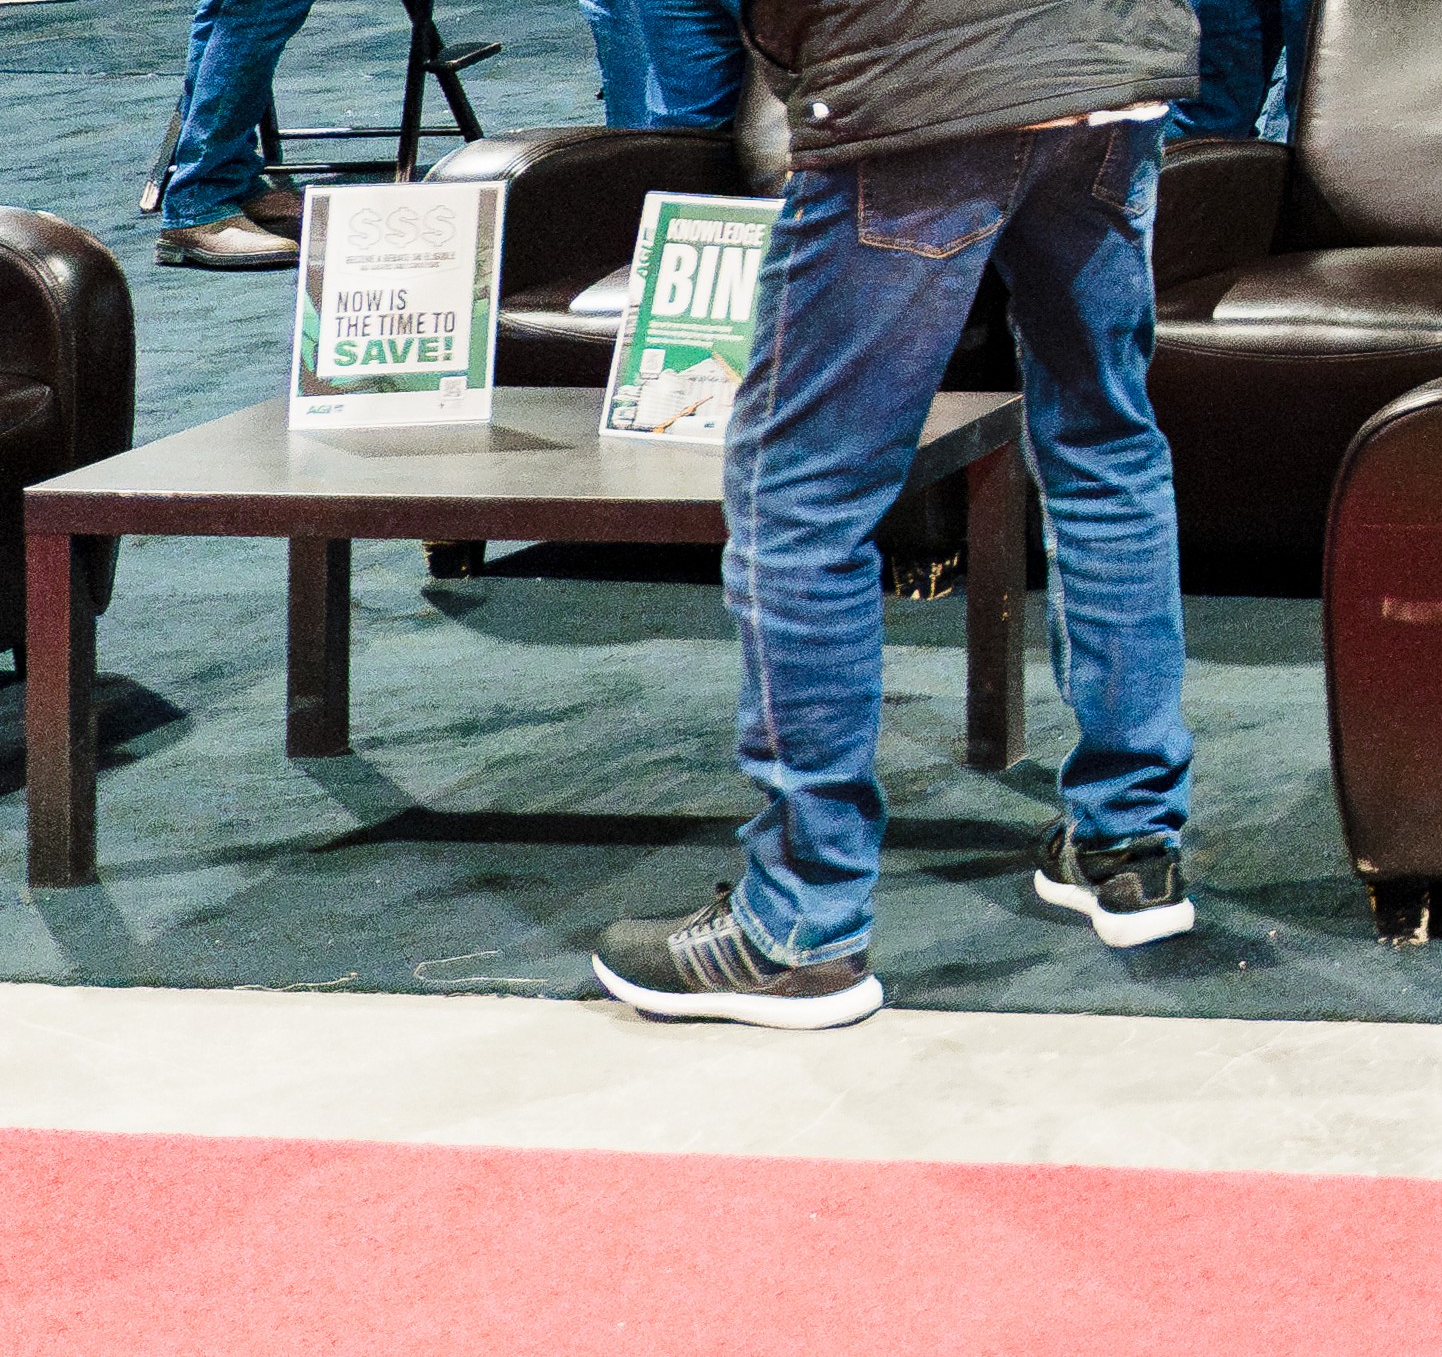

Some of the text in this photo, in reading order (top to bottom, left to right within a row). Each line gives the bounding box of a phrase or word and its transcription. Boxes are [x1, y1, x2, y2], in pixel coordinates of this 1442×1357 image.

[667, 217, 768, 245] KNOWLEDGE
[651, 242, 762, 321] BIN
[337, 289, 408, 313] NOW IS
[335, 311, 456, 338] THE TIME TO
[333, 336, 455, 367] SAVE!
